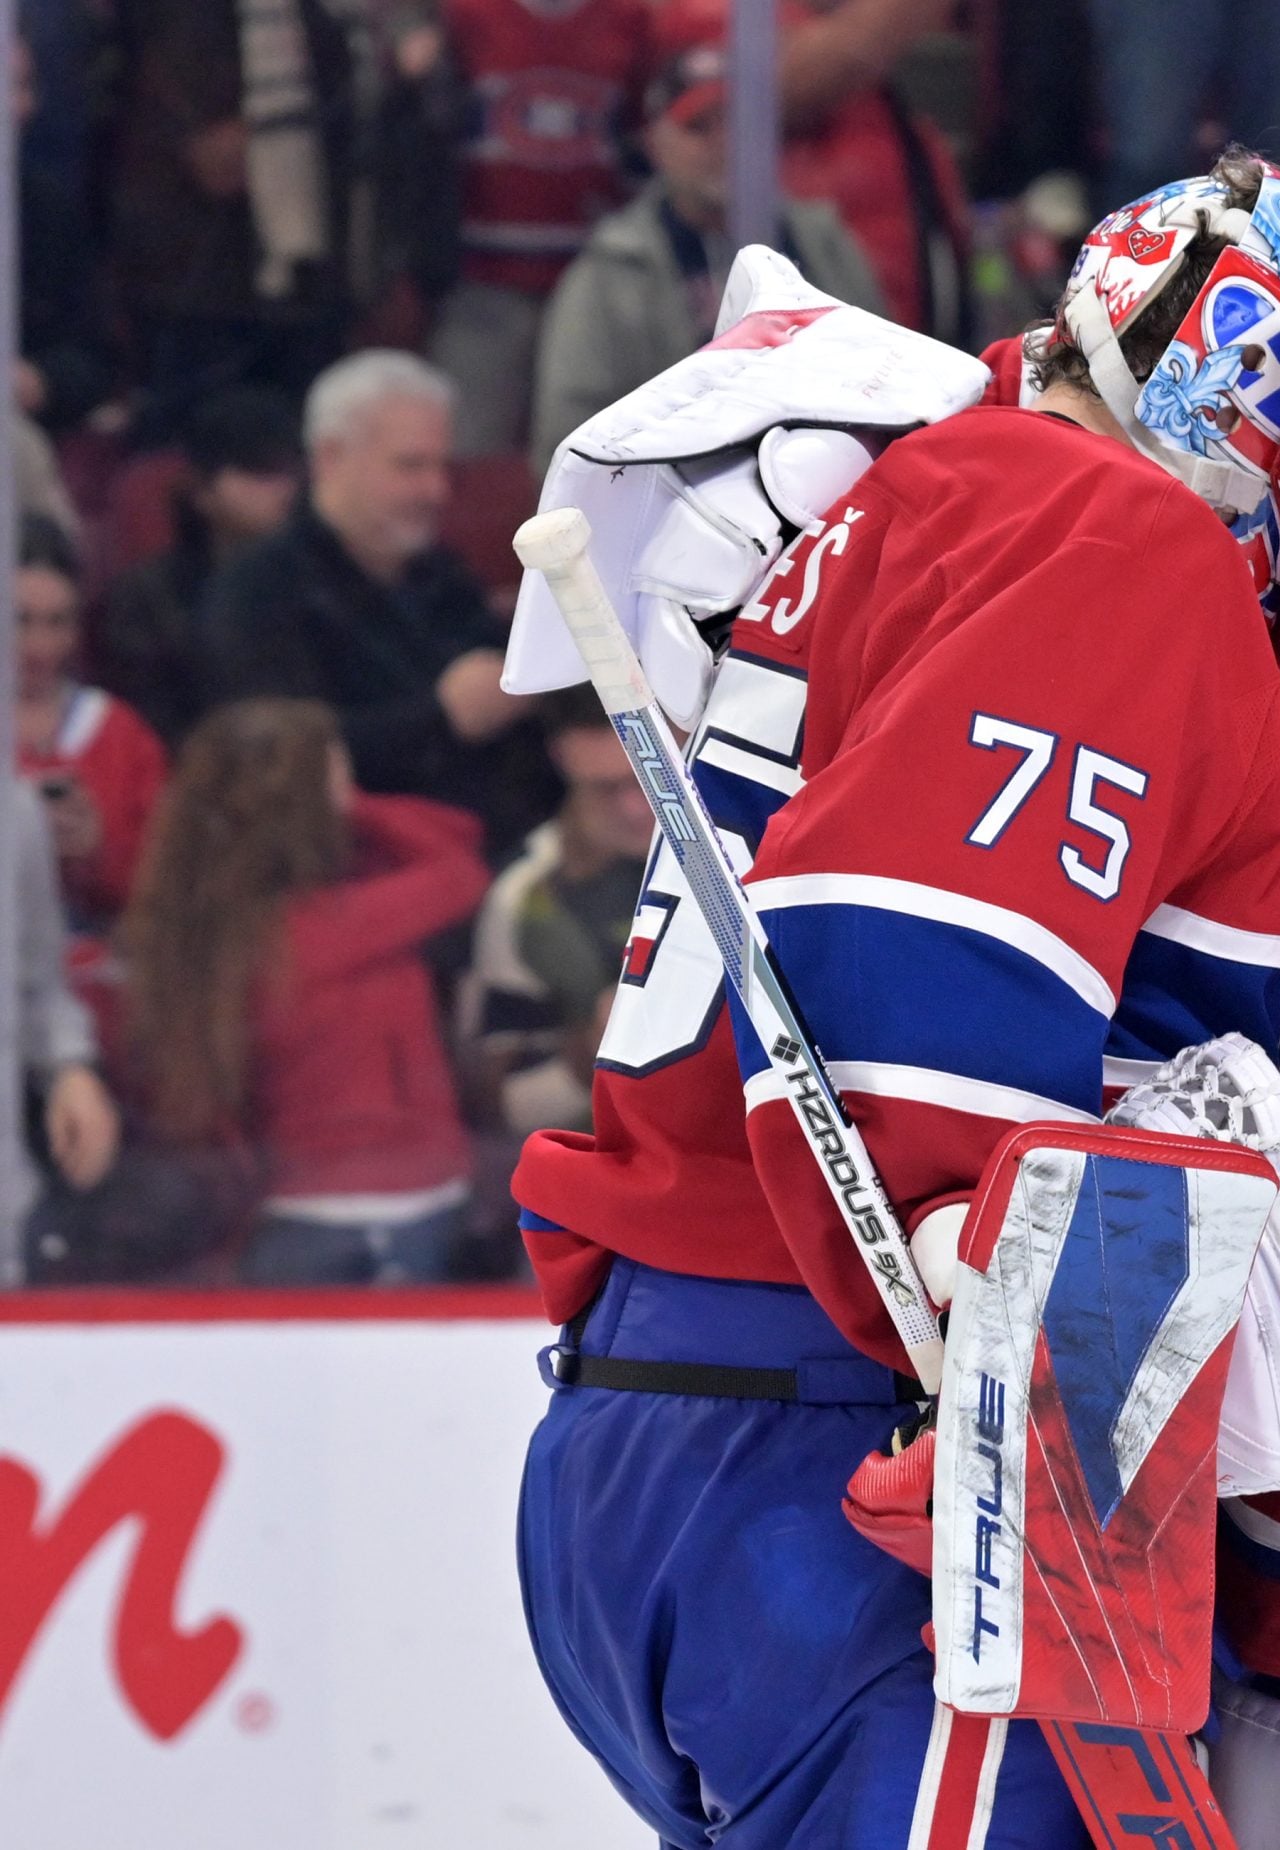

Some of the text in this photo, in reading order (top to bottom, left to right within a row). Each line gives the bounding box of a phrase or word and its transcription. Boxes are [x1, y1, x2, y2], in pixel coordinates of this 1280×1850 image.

[621, 709, 699, 843] RUE
[963, 709, 1151, 904] 75
[785, 1069, 890, 1248] HZRDUS
[972, 1371, 1006, 1666] TRUE
